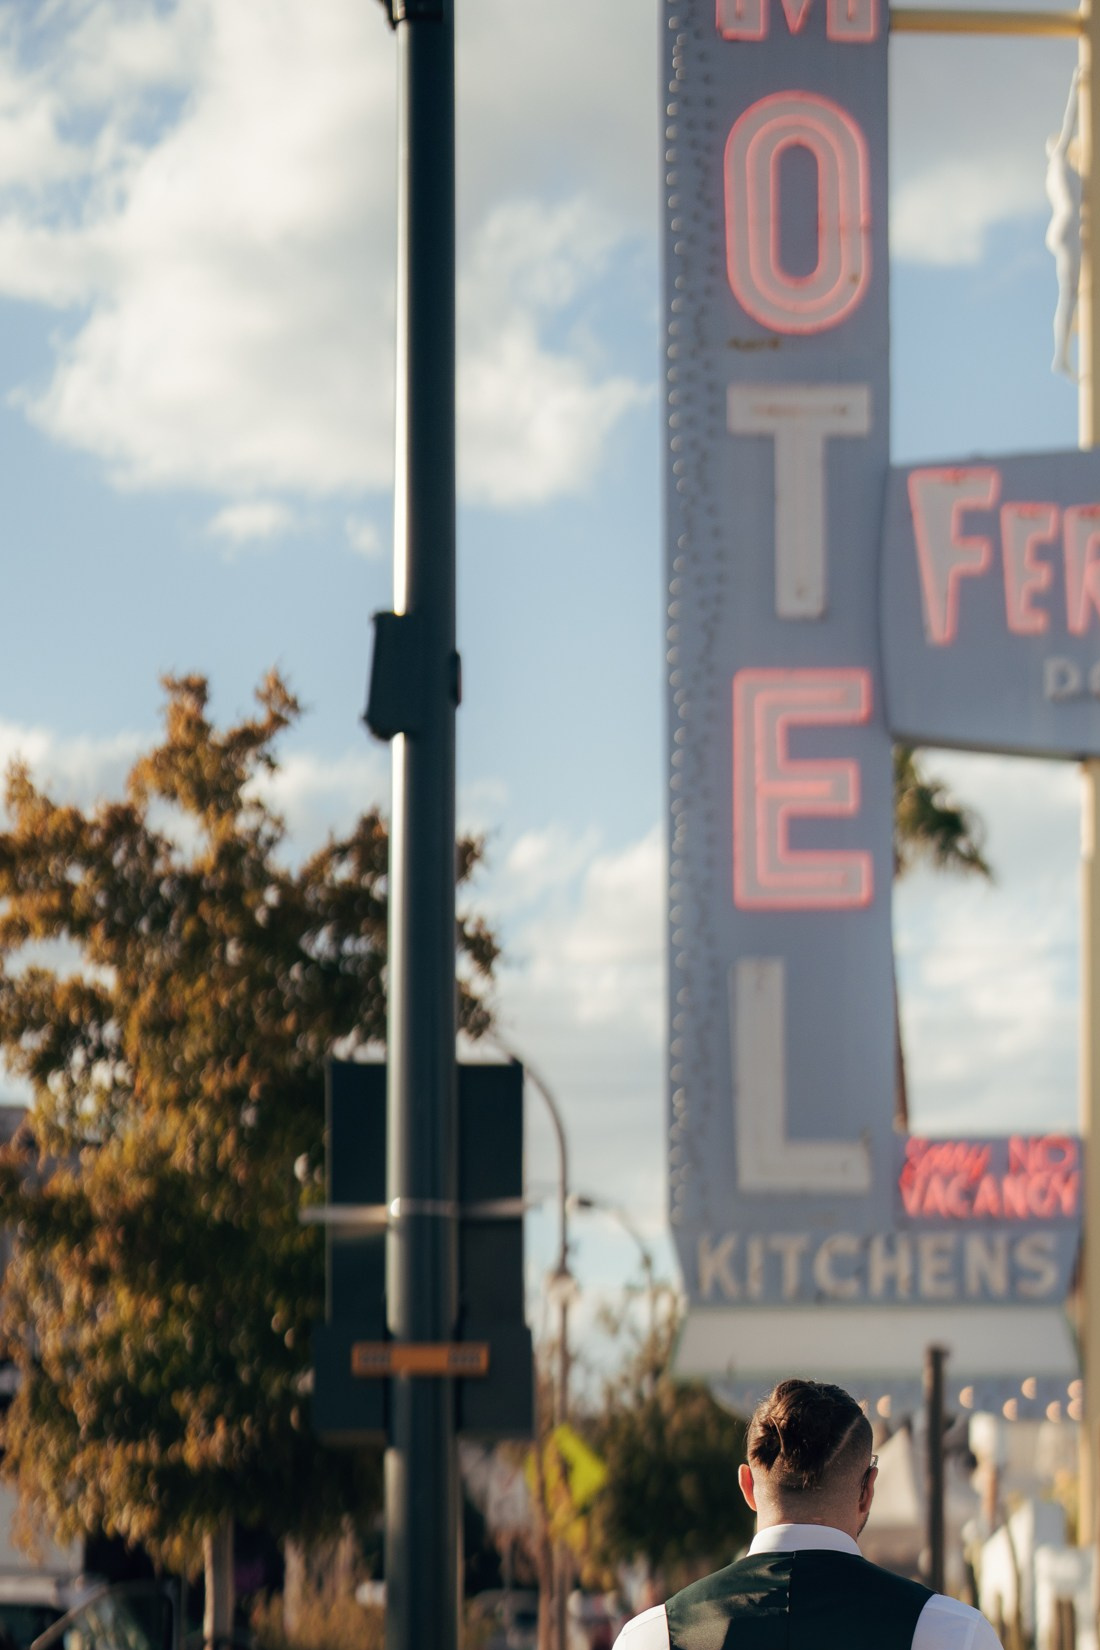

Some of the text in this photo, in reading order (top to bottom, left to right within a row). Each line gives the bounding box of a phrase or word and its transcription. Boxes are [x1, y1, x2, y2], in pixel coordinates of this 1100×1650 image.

[715, 0, 880, 1190] OTEL
[1008, 1131, 1077, 1175] NO
[900, 1171, 1080, 1220] VACANCY
[697, 1231, 1058, 1300] KITCHENS
